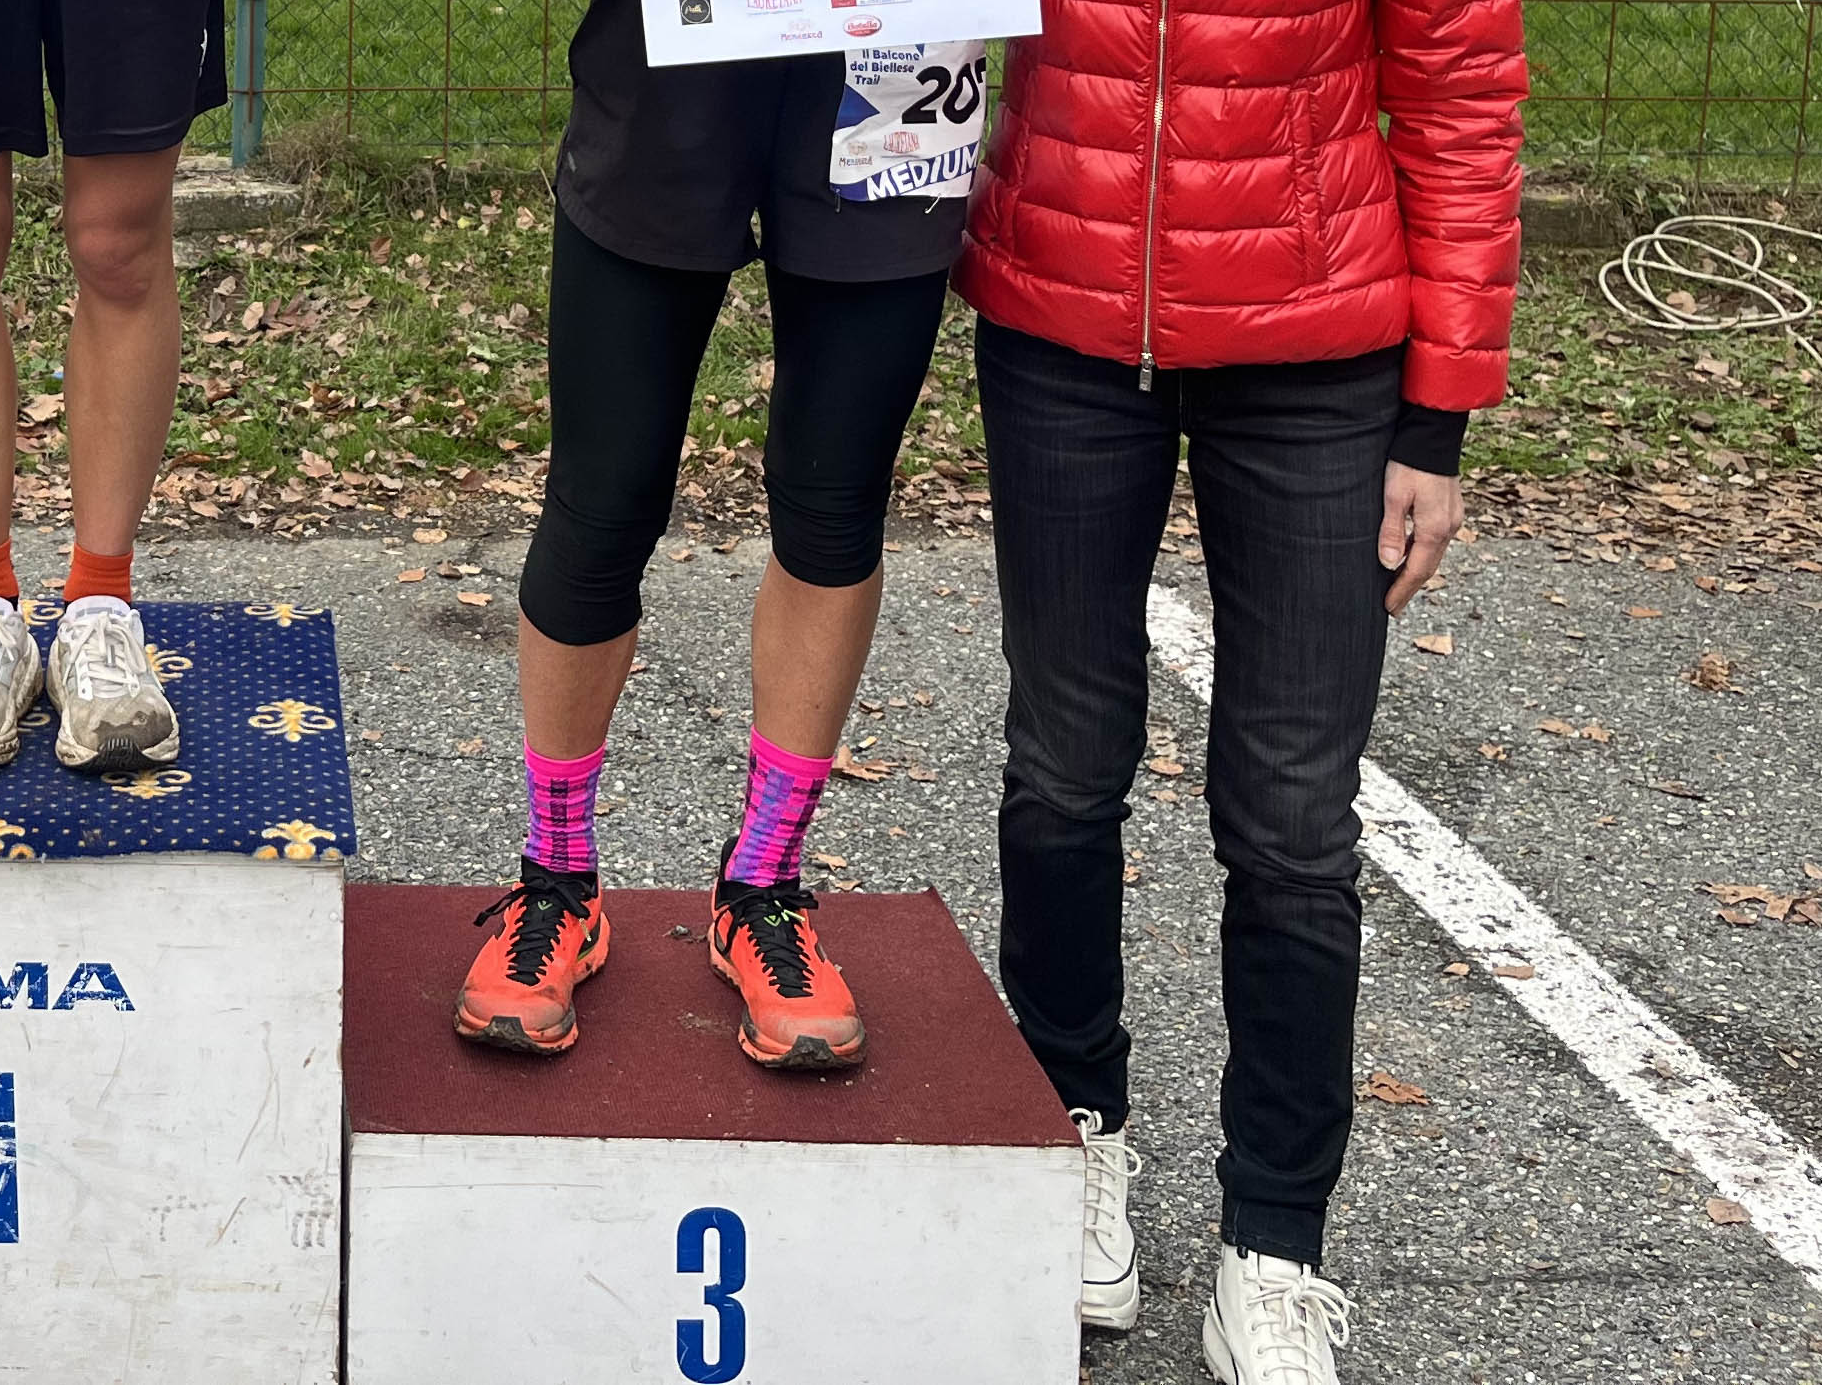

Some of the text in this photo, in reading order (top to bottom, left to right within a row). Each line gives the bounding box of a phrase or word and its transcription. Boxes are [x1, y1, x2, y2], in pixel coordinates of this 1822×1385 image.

[873, 50, 920, 61] Balcone
[850, 61, 915, 73] del Biellese
[855, 74, 880, 85] Trail
[866, 145, 978, 201] MEDIUM
[676, 1206, 746, 1384] 3
